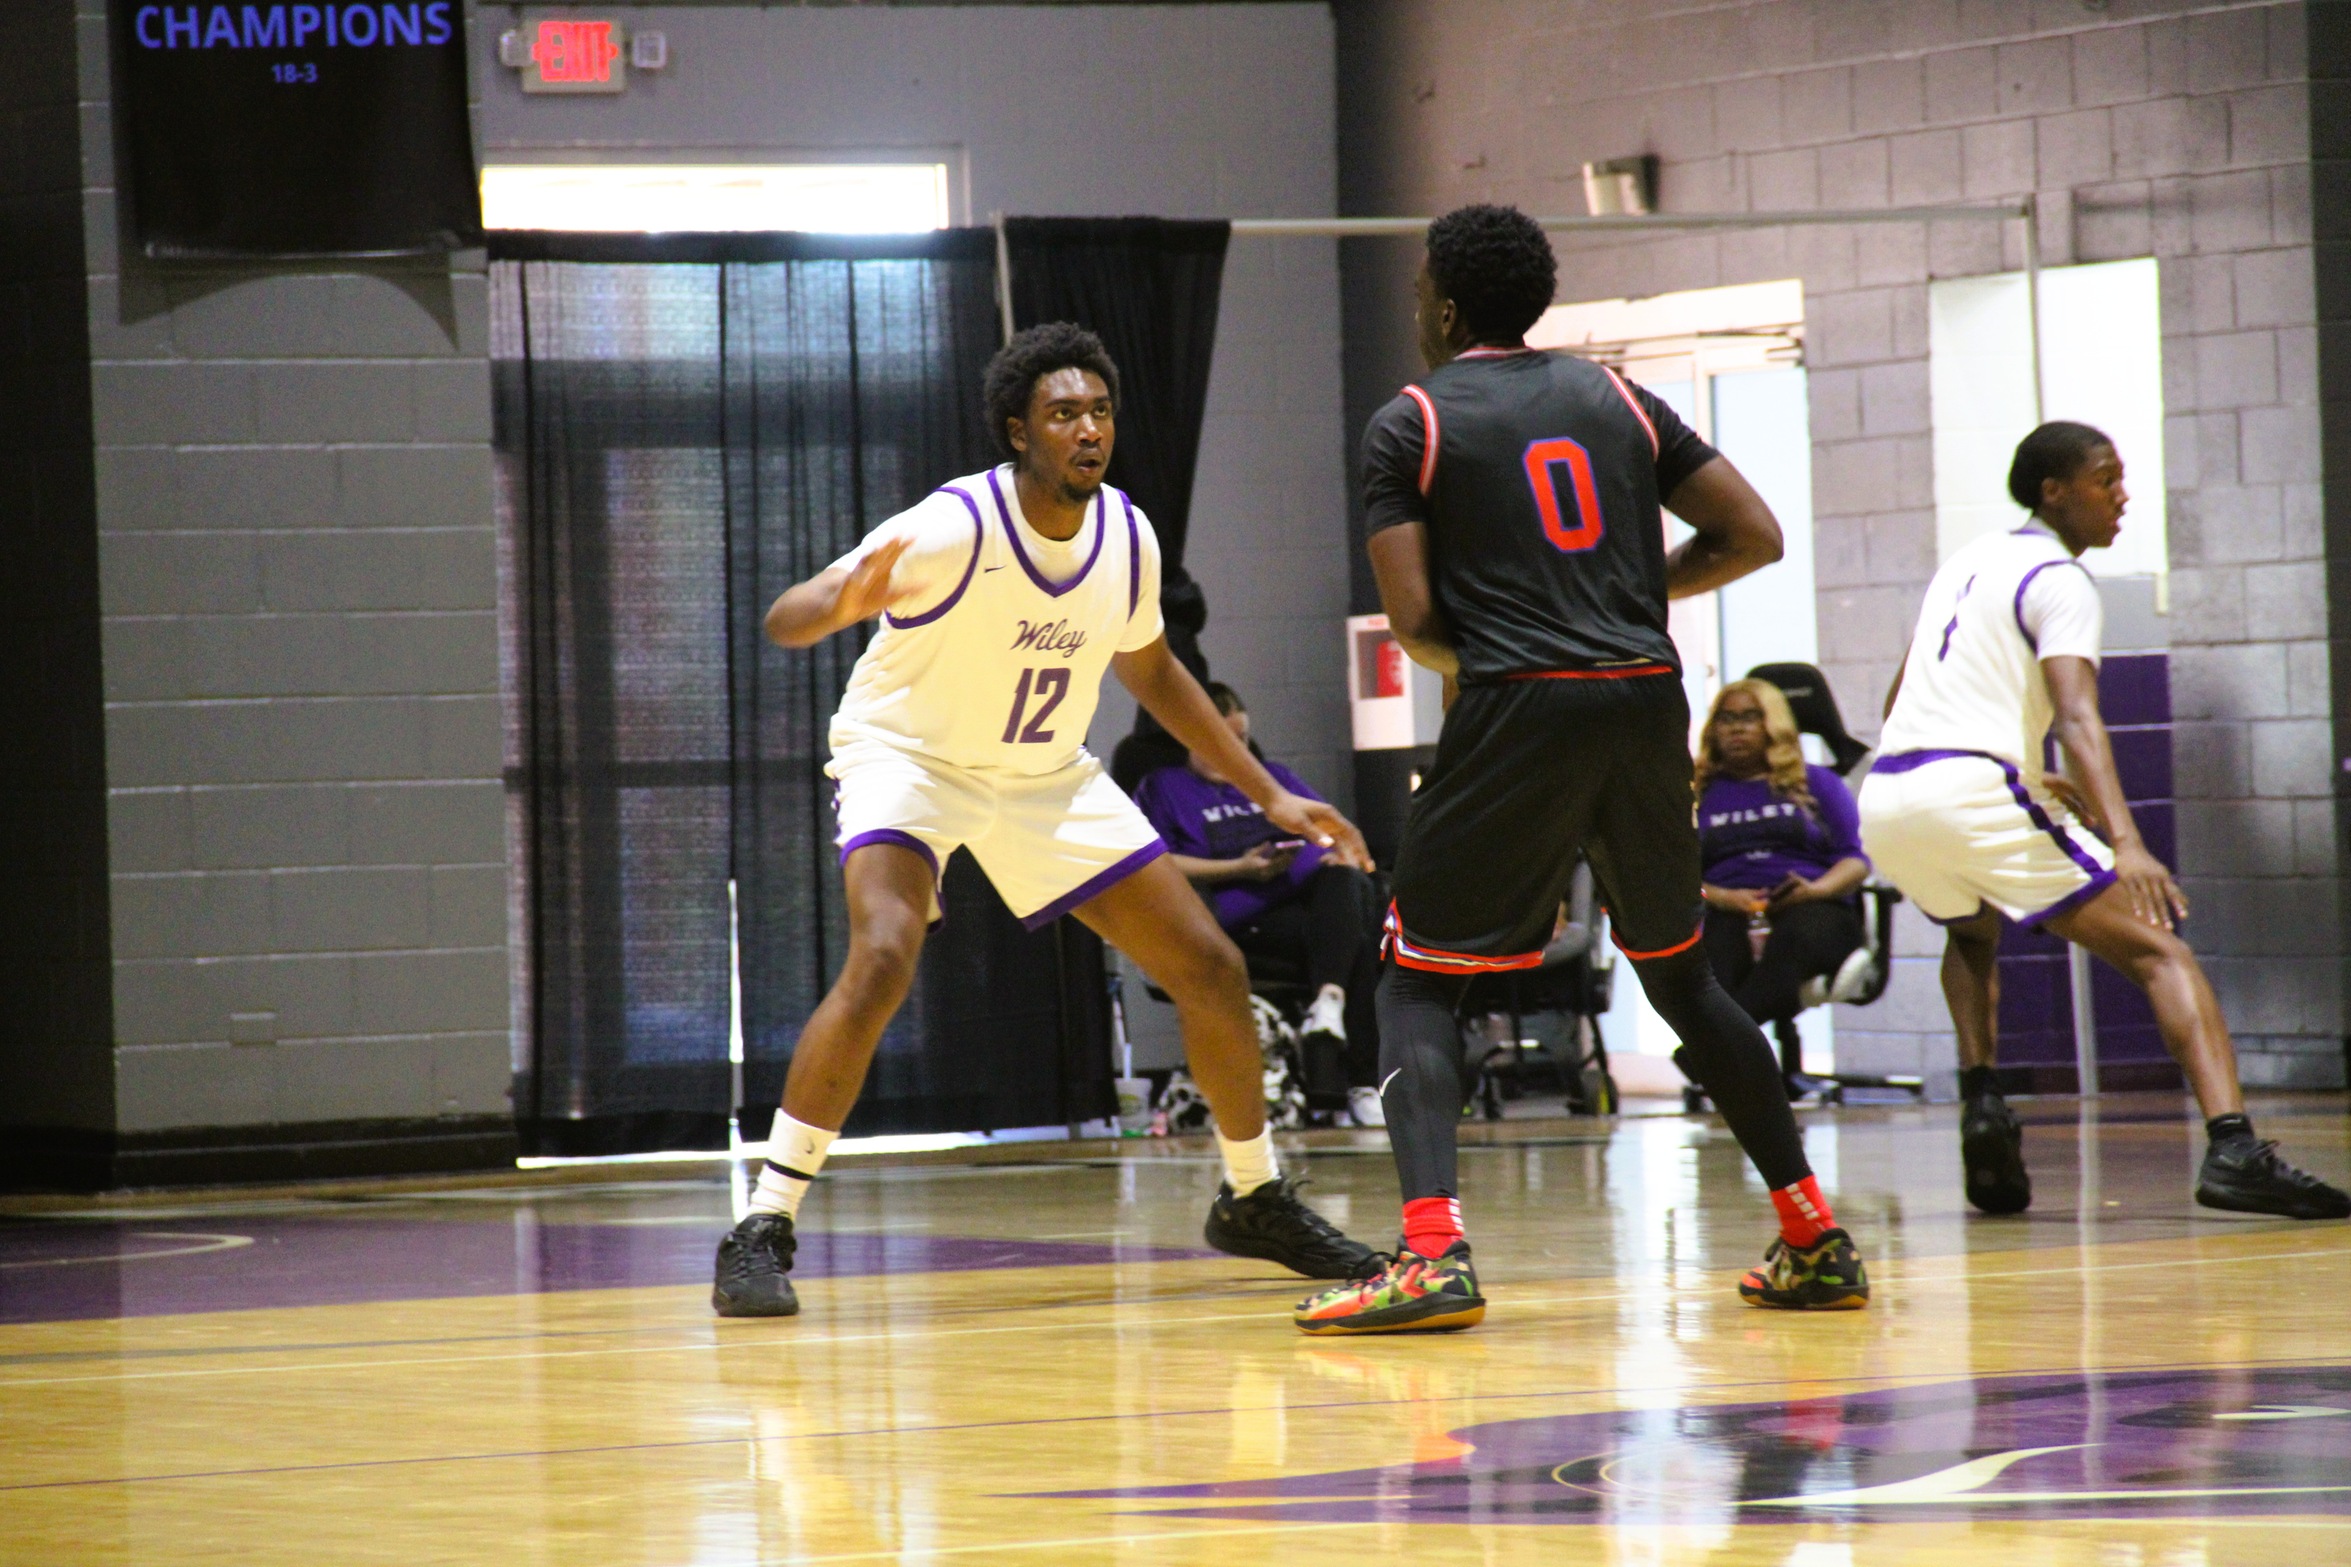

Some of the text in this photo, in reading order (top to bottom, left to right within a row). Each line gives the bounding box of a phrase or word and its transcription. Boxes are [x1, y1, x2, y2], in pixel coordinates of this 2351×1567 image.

[134, 1, 451, 49] CHAMPIONS
[538, 20, 612, 82] EXIT
[271, 62, 318, 83] 18-3
[1522, 436, 1606, 554] 0
[1009, 618, 1087, 659] Wiley
[1000, 667, 1071, 744] 12
